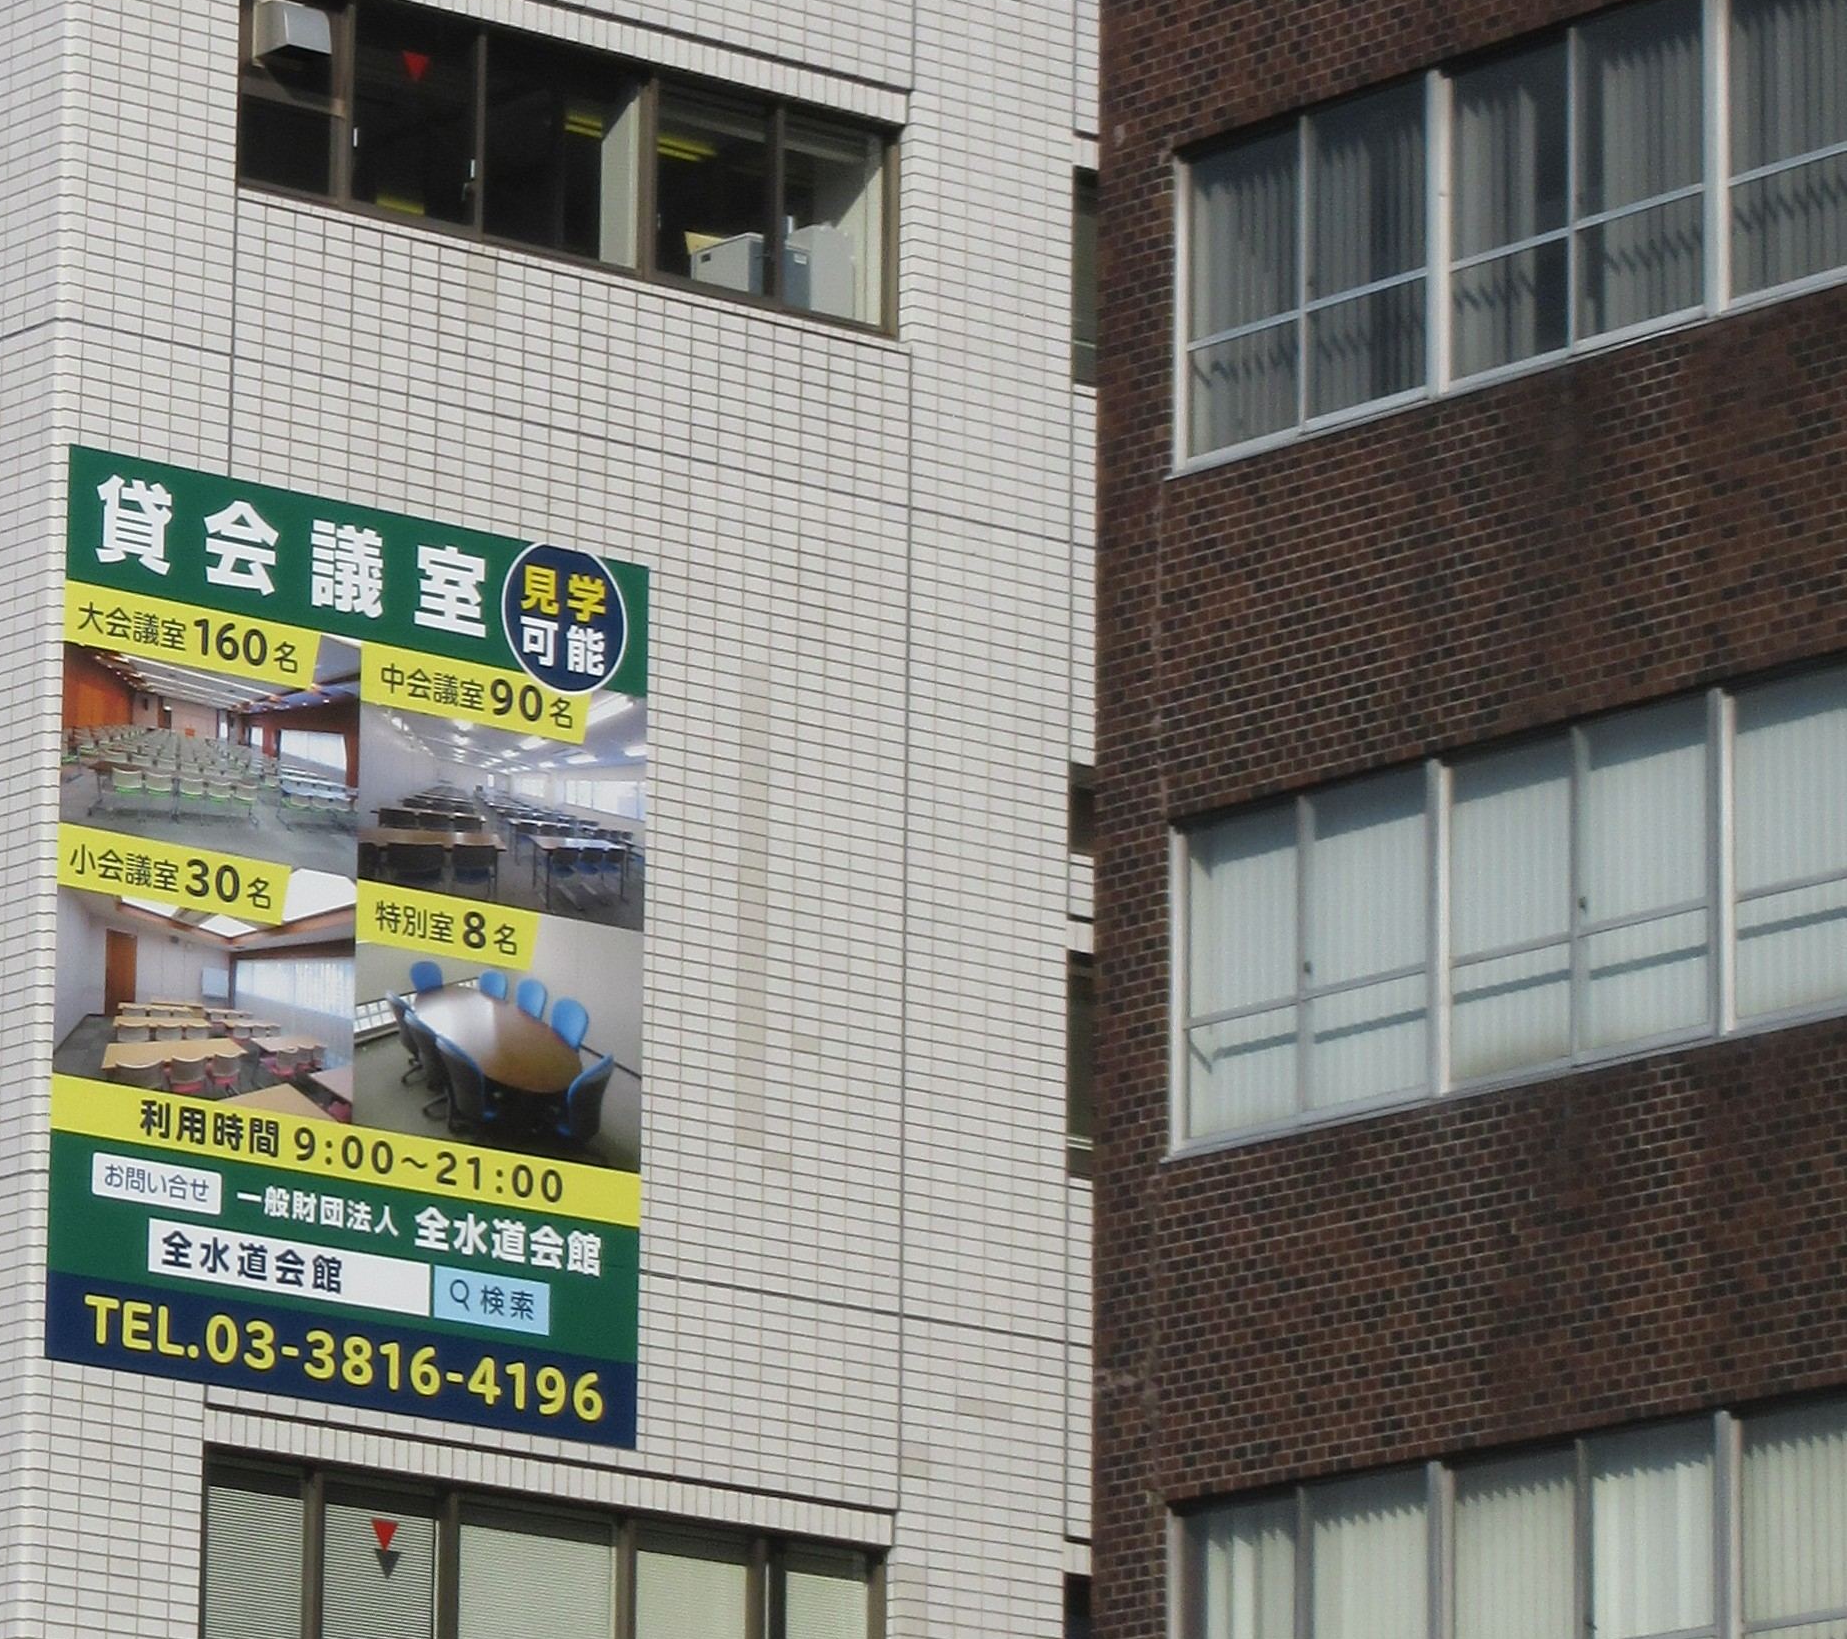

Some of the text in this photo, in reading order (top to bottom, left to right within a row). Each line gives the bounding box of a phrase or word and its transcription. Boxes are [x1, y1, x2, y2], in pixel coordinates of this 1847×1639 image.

[95, 473, 489, 639] 貸会議室
[520, 564, 607, 620] 見学
[519, 615, 606, 677] 可能
[140, 1099, 280, 1158] 利用時間
[104, 1162, 210, 1203] お問い合せ
[236, 1186, 602, 1277] 一般財団法人 全水道会館
[160, 1230, 343, 1295] 全水道会館
[480, 1284, 535, 1321] 検索
